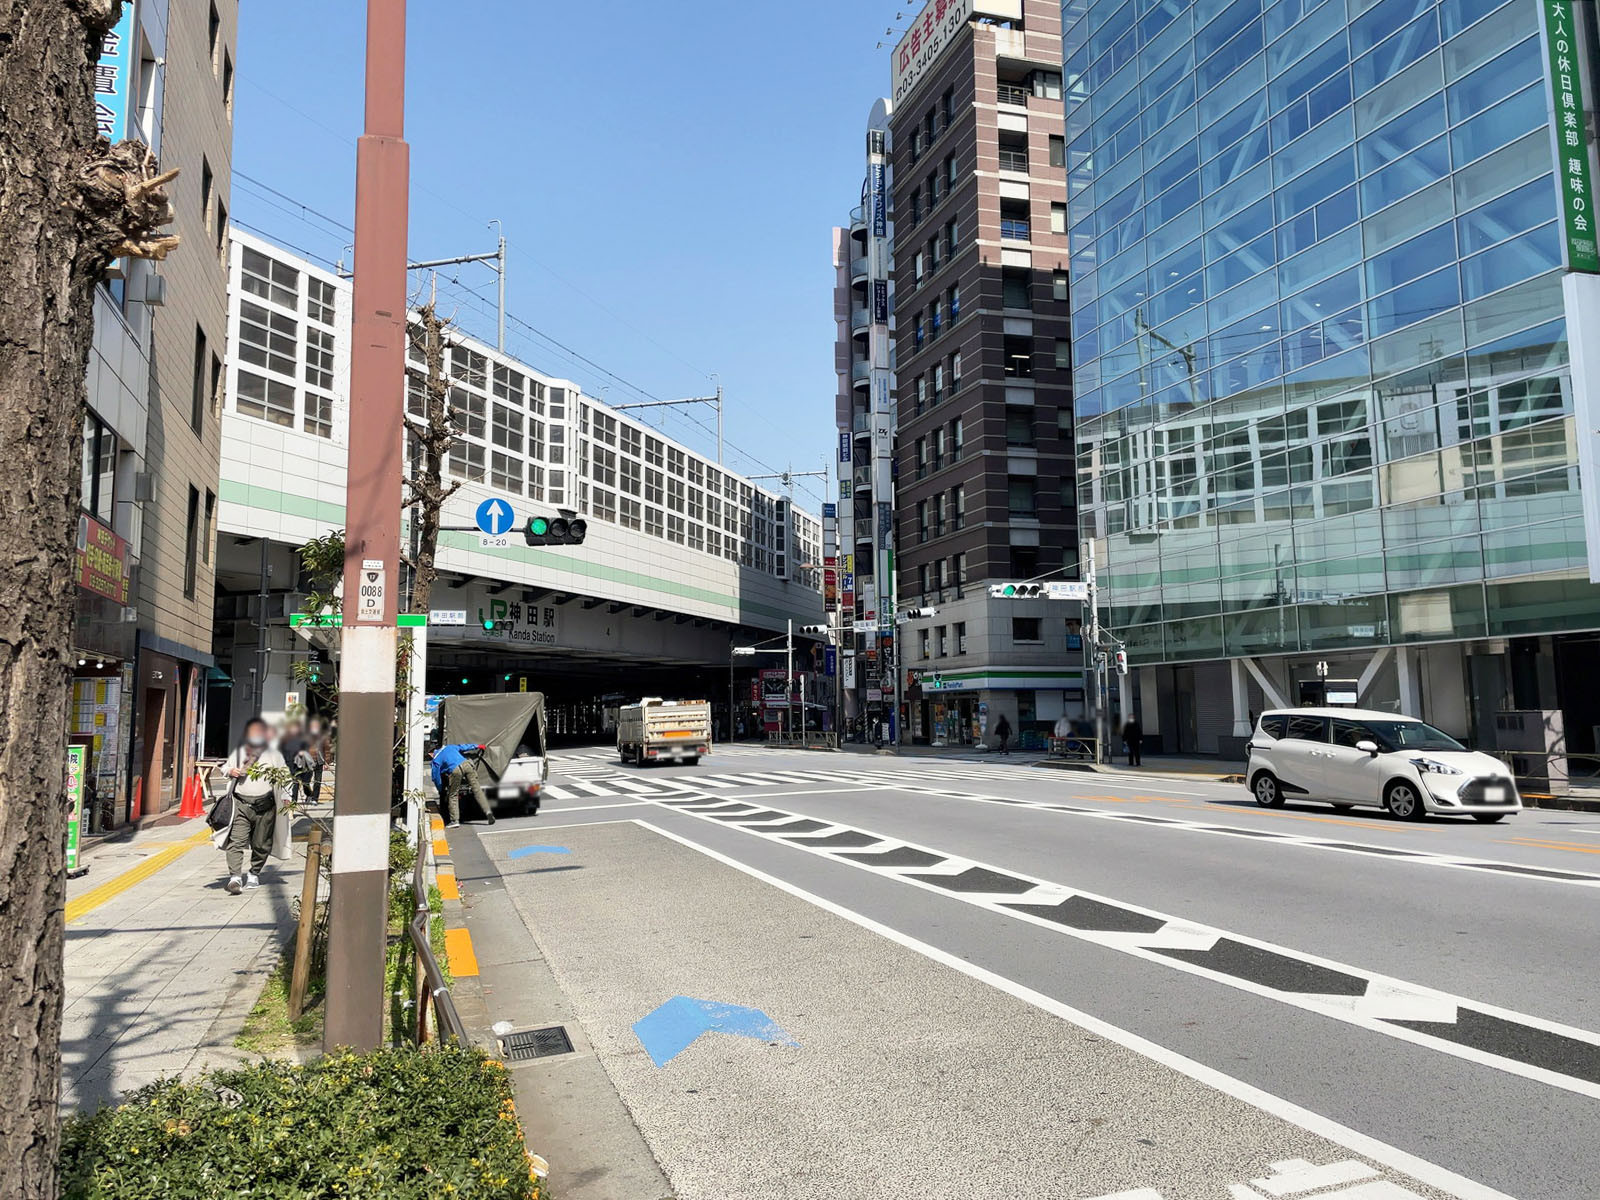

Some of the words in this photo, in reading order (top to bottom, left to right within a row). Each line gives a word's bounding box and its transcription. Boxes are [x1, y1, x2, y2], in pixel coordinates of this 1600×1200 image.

[902, 0, 967, 93] 03-3405-1301
[1552, 2, 1578, 147] 大人の休日倶楽部
[1568, 157, 1588, 232] 趣味の会
[362, 585, 382, 597] 0088
[367, 599, 375, 607] D
[478, 599, 508, 624] JR
[509, 601, 554, 627] 神田駅
[509, 629, 530, 640] Kanda
[532, 630, 555, 643] Station
